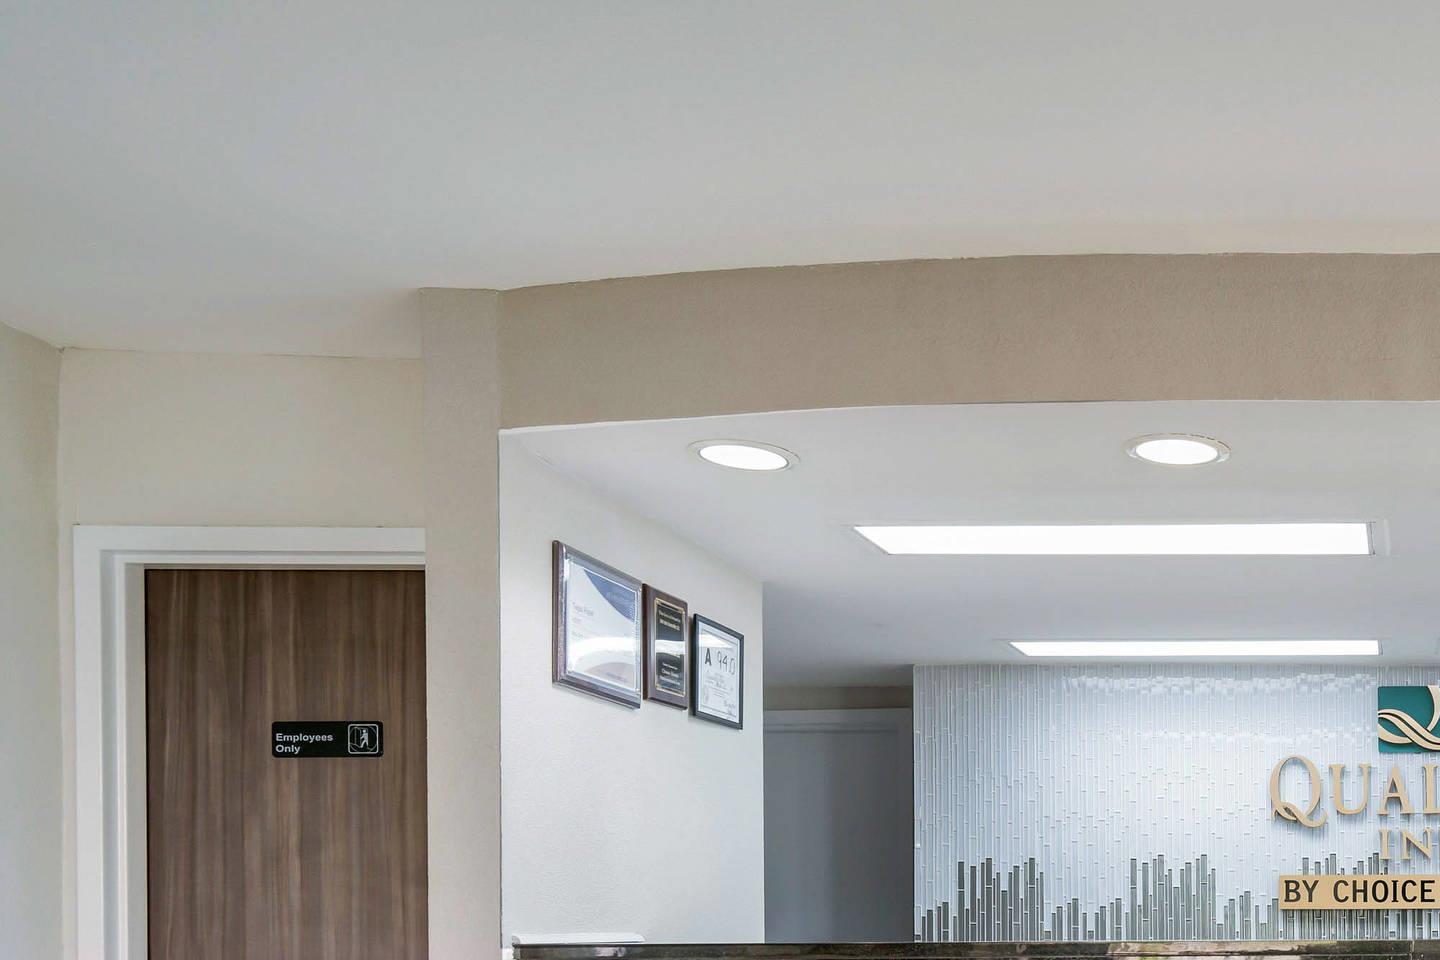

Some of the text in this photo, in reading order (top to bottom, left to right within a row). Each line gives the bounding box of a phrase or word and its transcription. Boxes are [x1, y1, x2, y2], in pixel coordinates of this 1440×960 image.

[704, 647, 712, 666] A
[275, 732, 334, 744] Employees
[275, 744, 301, 755] Only
[1284, 880, 1319, 904] BY
[1333, 879, 1436, 904] CHOICE
